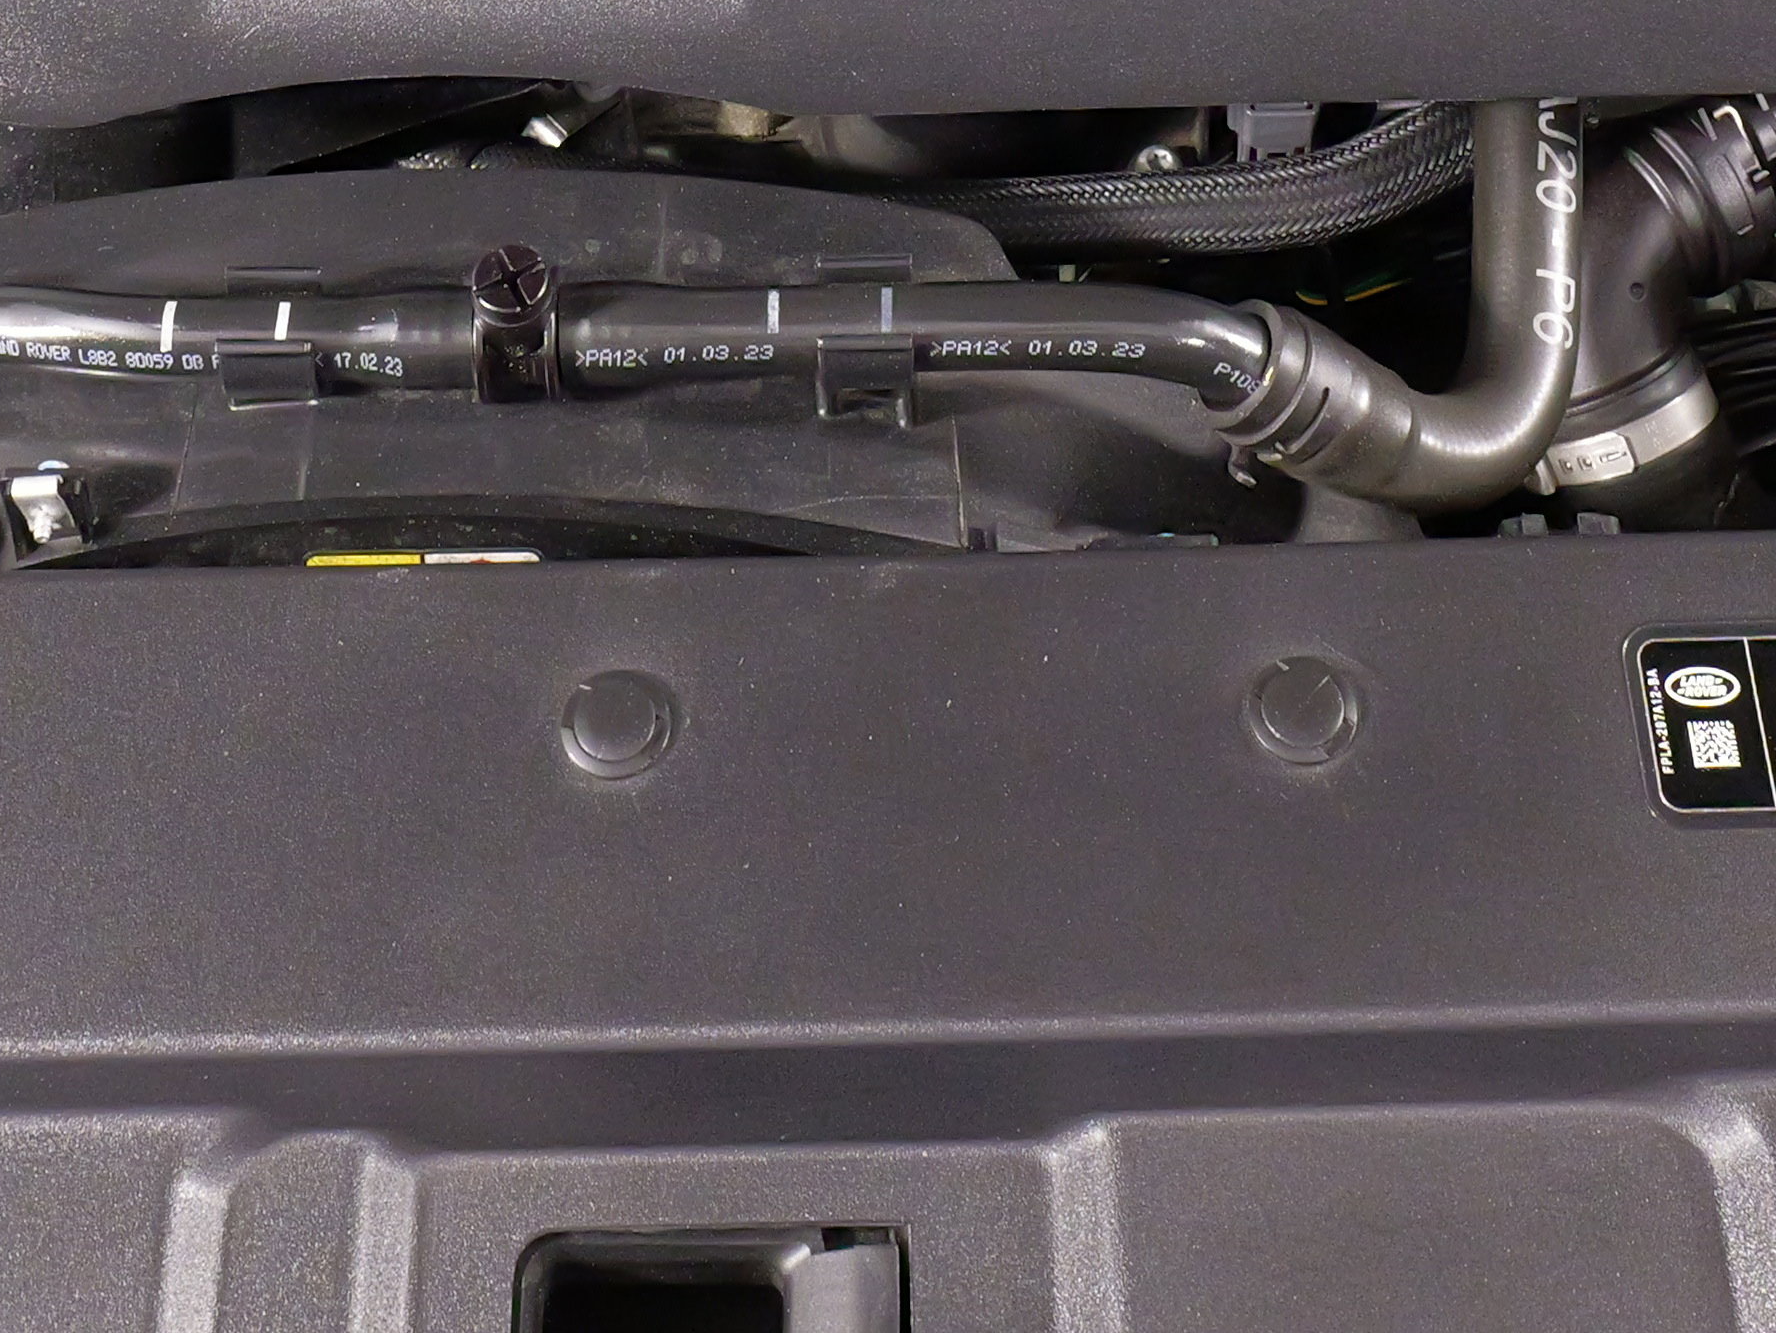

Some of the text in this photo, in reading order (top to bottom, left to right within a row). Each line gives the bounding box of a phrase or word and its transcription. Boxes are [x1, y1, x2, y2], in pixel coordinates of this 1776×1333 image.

[663, 344, 774, 364] 01.03.23
[1028, 340, 1146, 359] 01.03.23
[26, 342, 72, 363] ROVER
[333, 353, 404, 378] 17.02.23
[1680, 674, 1719, 688] LAND
[1682, 685, 1728, 698] ROVER
